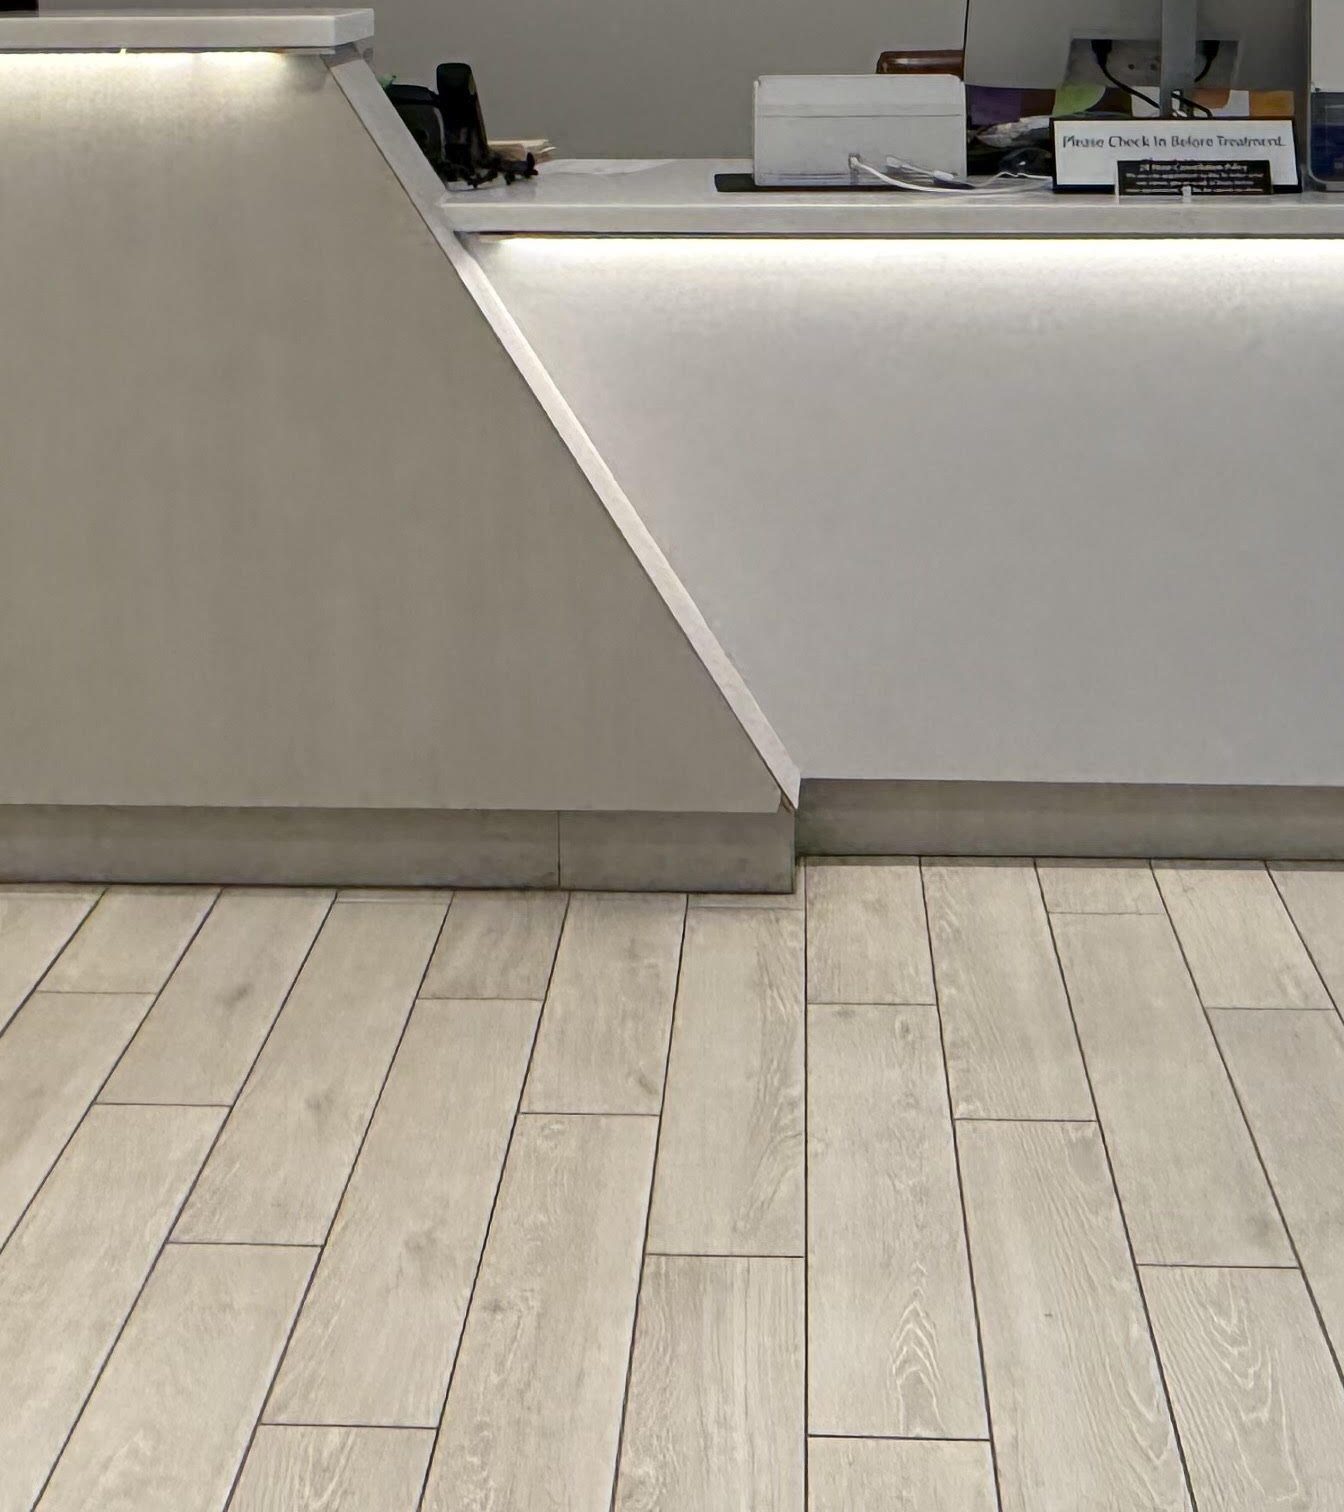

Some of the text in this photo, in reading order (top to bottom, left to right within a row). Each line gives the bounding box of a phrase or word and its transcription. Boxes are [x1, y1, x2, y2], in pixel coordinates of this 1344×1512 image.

[1062, 135, 1104, 148] Please
[1108, 135, 1150, 148] Check
[1153, 135, 1167, 147] In
[1171, 135, 1214, 148] Before
